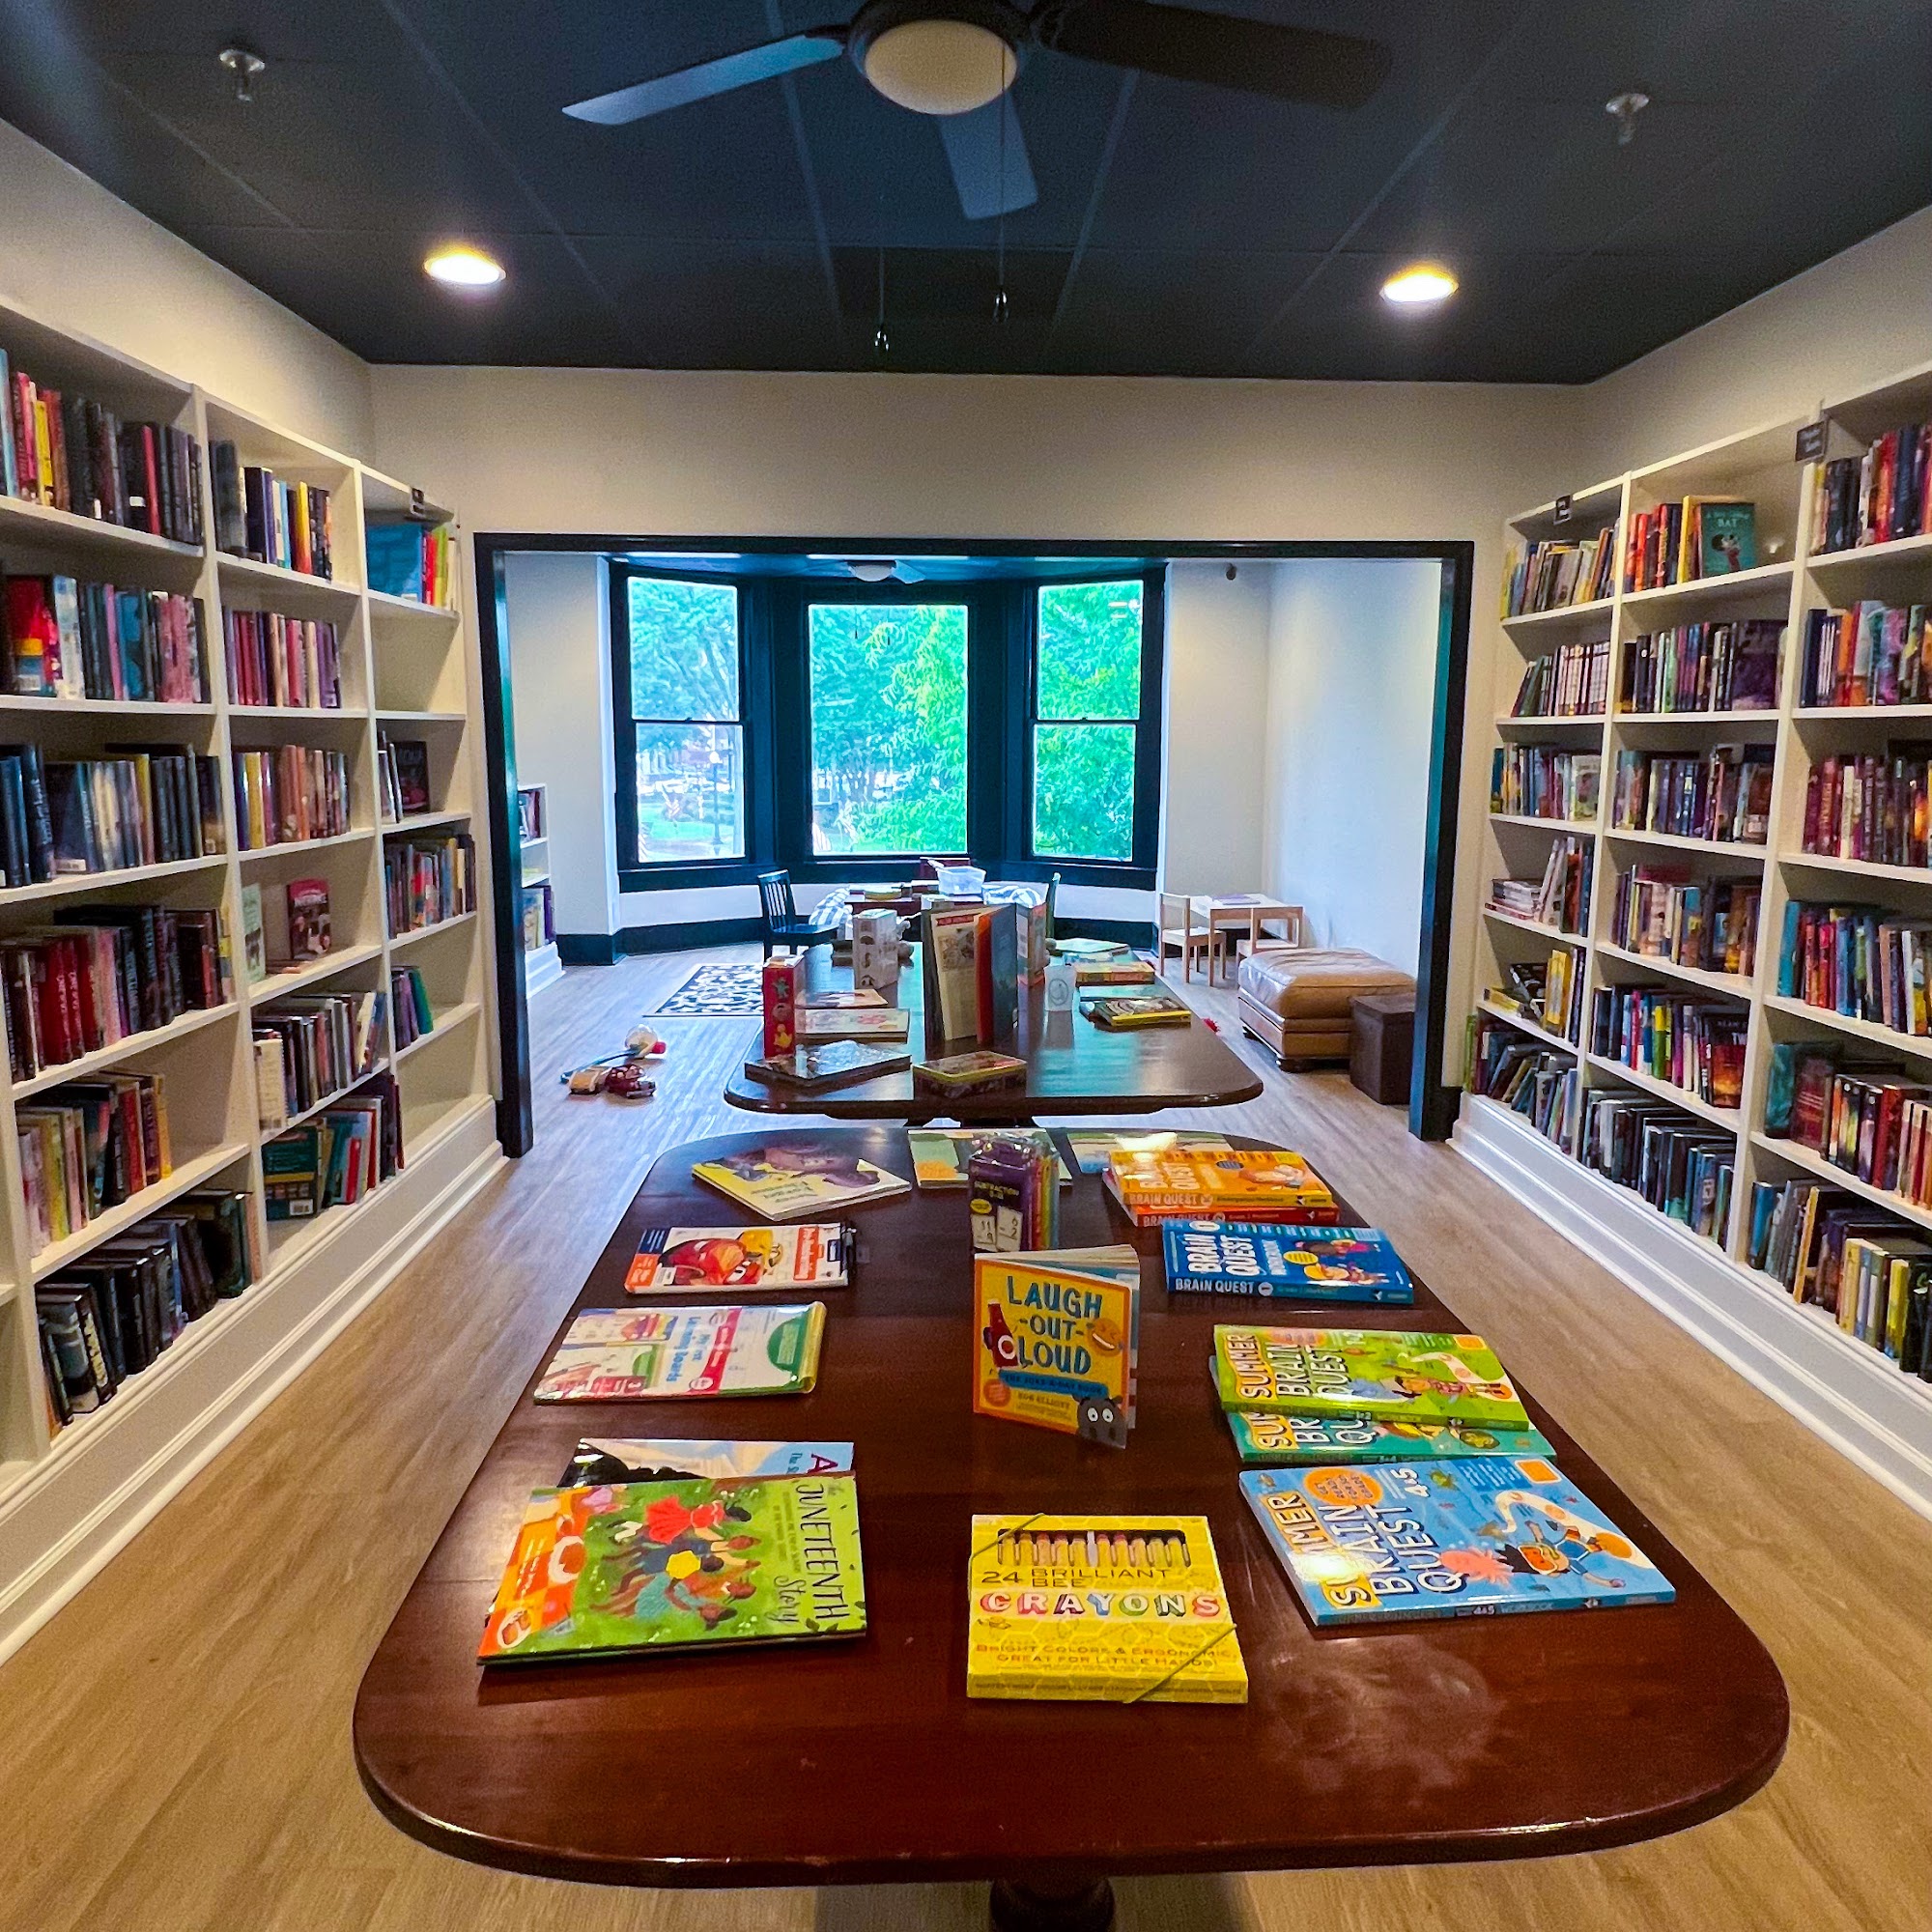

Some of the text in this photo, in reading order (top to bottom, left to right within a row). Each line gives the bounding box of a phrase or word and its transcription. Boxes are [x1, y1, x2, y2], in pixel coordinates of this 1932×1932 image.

[1129, 1193, 1161, 1206] BRAIN
[1163, 1193, 1198, 1206] QUEST
[1183, 1234, 1223, 1273] BRAIN
[1220, 1235, 1262, 1276] QUEST
[1007, 1275, 1103, 1319] LAUGH
[1175, 1278, 1212, 1293] BRAIN
[1215, 1280, 1255, 1294] QUEST
[1017, 1336, 1092, 1376] LOUD
[1227, 1334, 1272, 1399] SUMMER
[1265, 1342, 1312, 1397] BRAIN
[795, 1483, 851, 1620] JUNETEENTH
[1267, 1493, 1372, 1606] SMER
[1318, 1504, 1415, 1595] BRAIN
[1365, 1503, 1469, 1593] QUEST
[981, 1568, 1172, 1585] 24 BRILLIANT
[1031, 1577, 1086, 1588] BEE
[765, 1575, 808, 1624] Story
[980, 1592, 1221, 1617] CRAYONS
[997, 1654, 1050, 1662] GREAT
[1057, 1655, 1091, 1663] FOR
[1095, 1656, 1151, 1664] LITTLE
